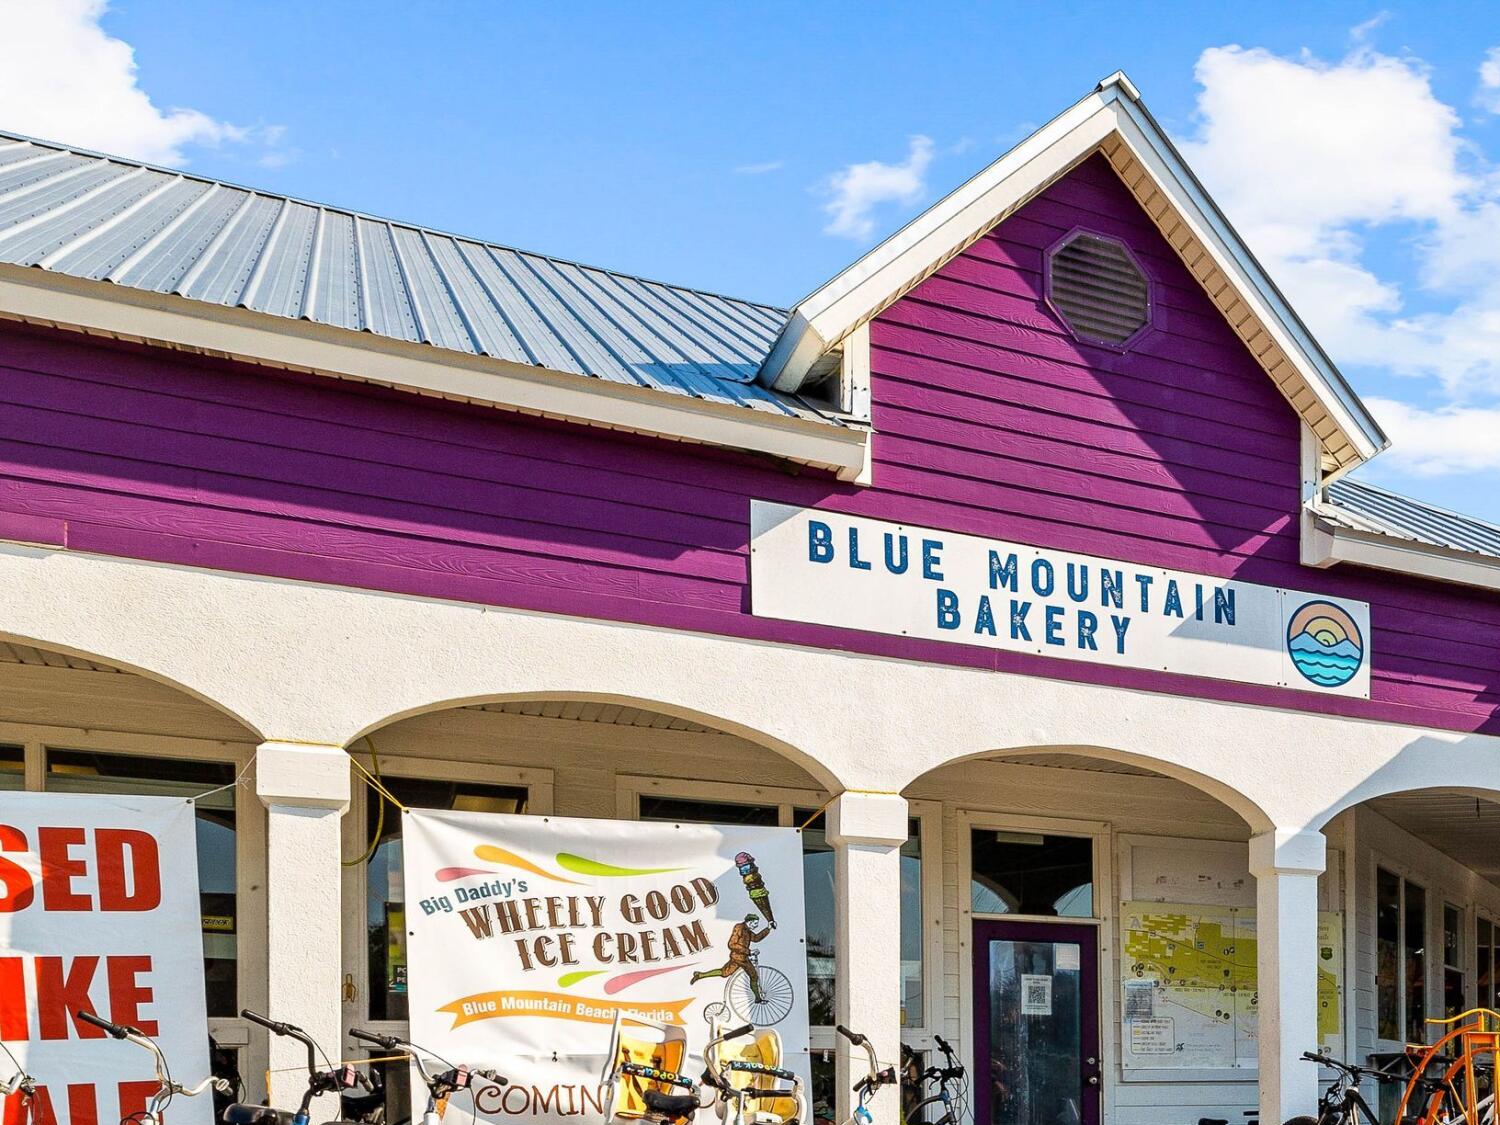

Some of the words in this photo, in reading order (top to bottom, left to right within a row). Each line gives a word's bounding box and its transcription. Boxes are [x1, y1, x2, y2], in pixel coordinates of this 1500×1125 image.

[808, 520, 944, 581] BLUE
[989, 549, 1236, 626] MOUNTAIN
[937, 588, 1131, 654] BAKERY
[419, 893, 453, 916] Big
[455, 878, 528, 904] Daddy's
[458, 895, 605, 941] WHEELY
[620, 877, 719, 925] GOOD
[514, 932, 580, 971] ICE
[592, 919, 713, 965] CREAM
[462, 999, 496, 1016] Blue
[501, 997, 571, 1013] Mountain
